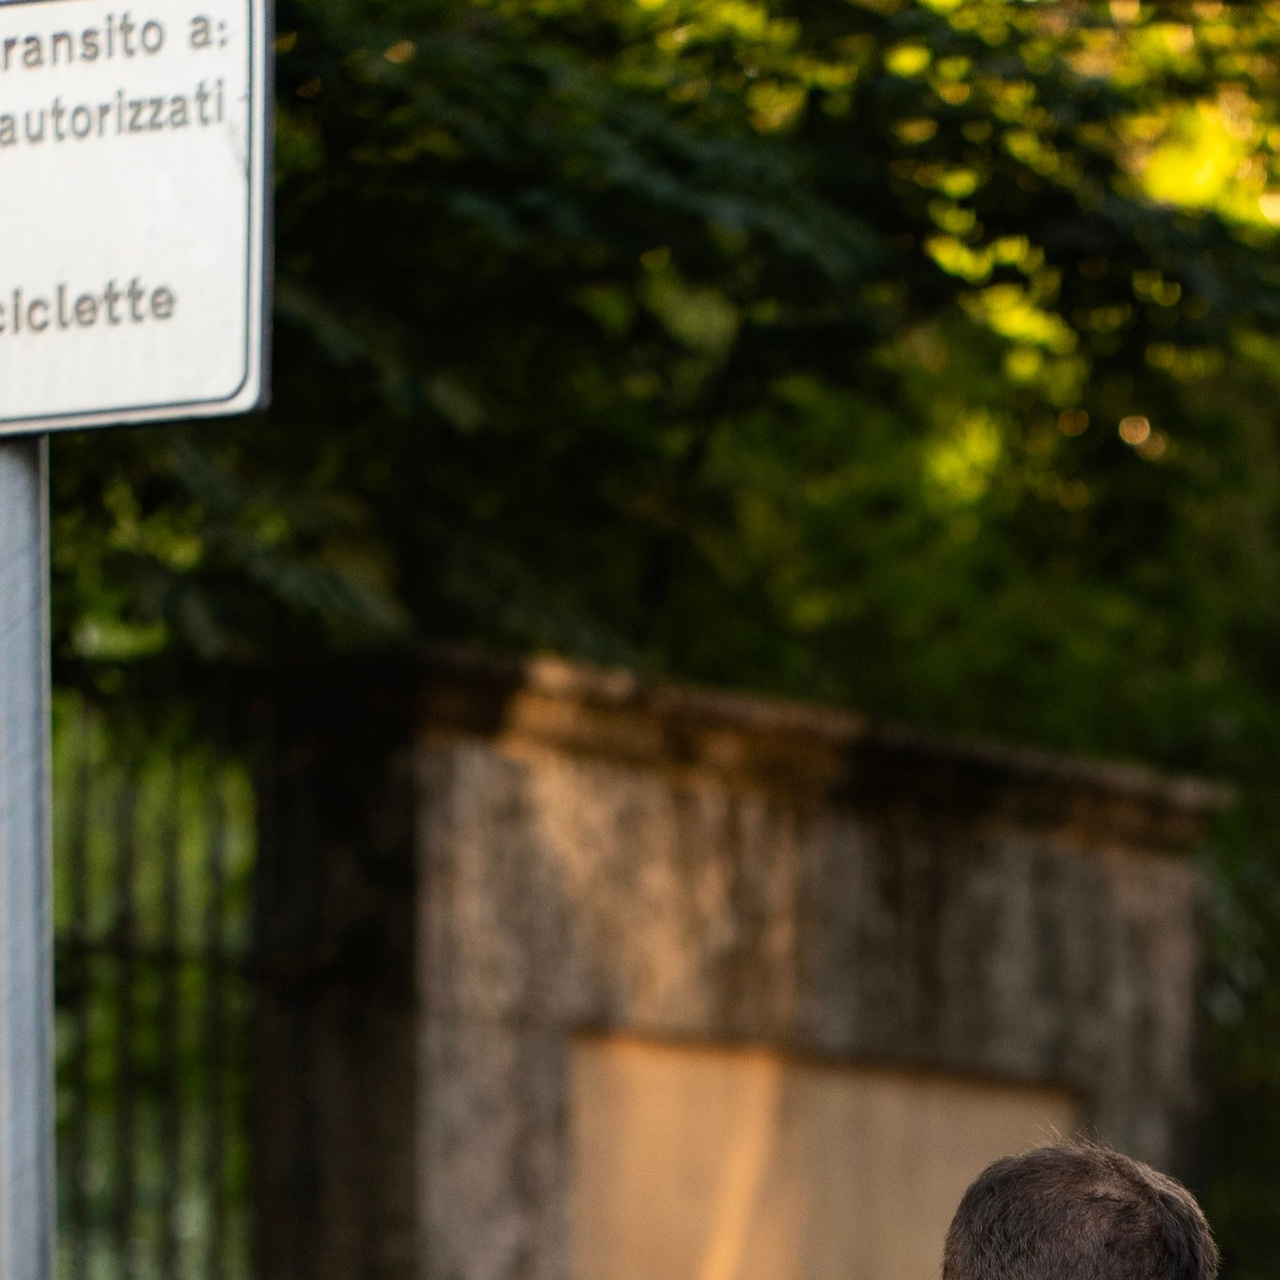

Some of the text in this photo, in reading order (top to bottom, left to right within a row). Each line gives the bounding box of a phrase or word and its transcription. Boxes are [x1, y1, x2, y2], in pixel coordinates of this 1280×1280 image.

[189, 15, 228, 49] a:
[0, 78, 225, 147] autorizzati
[0, 275, 176, 334] iclette
